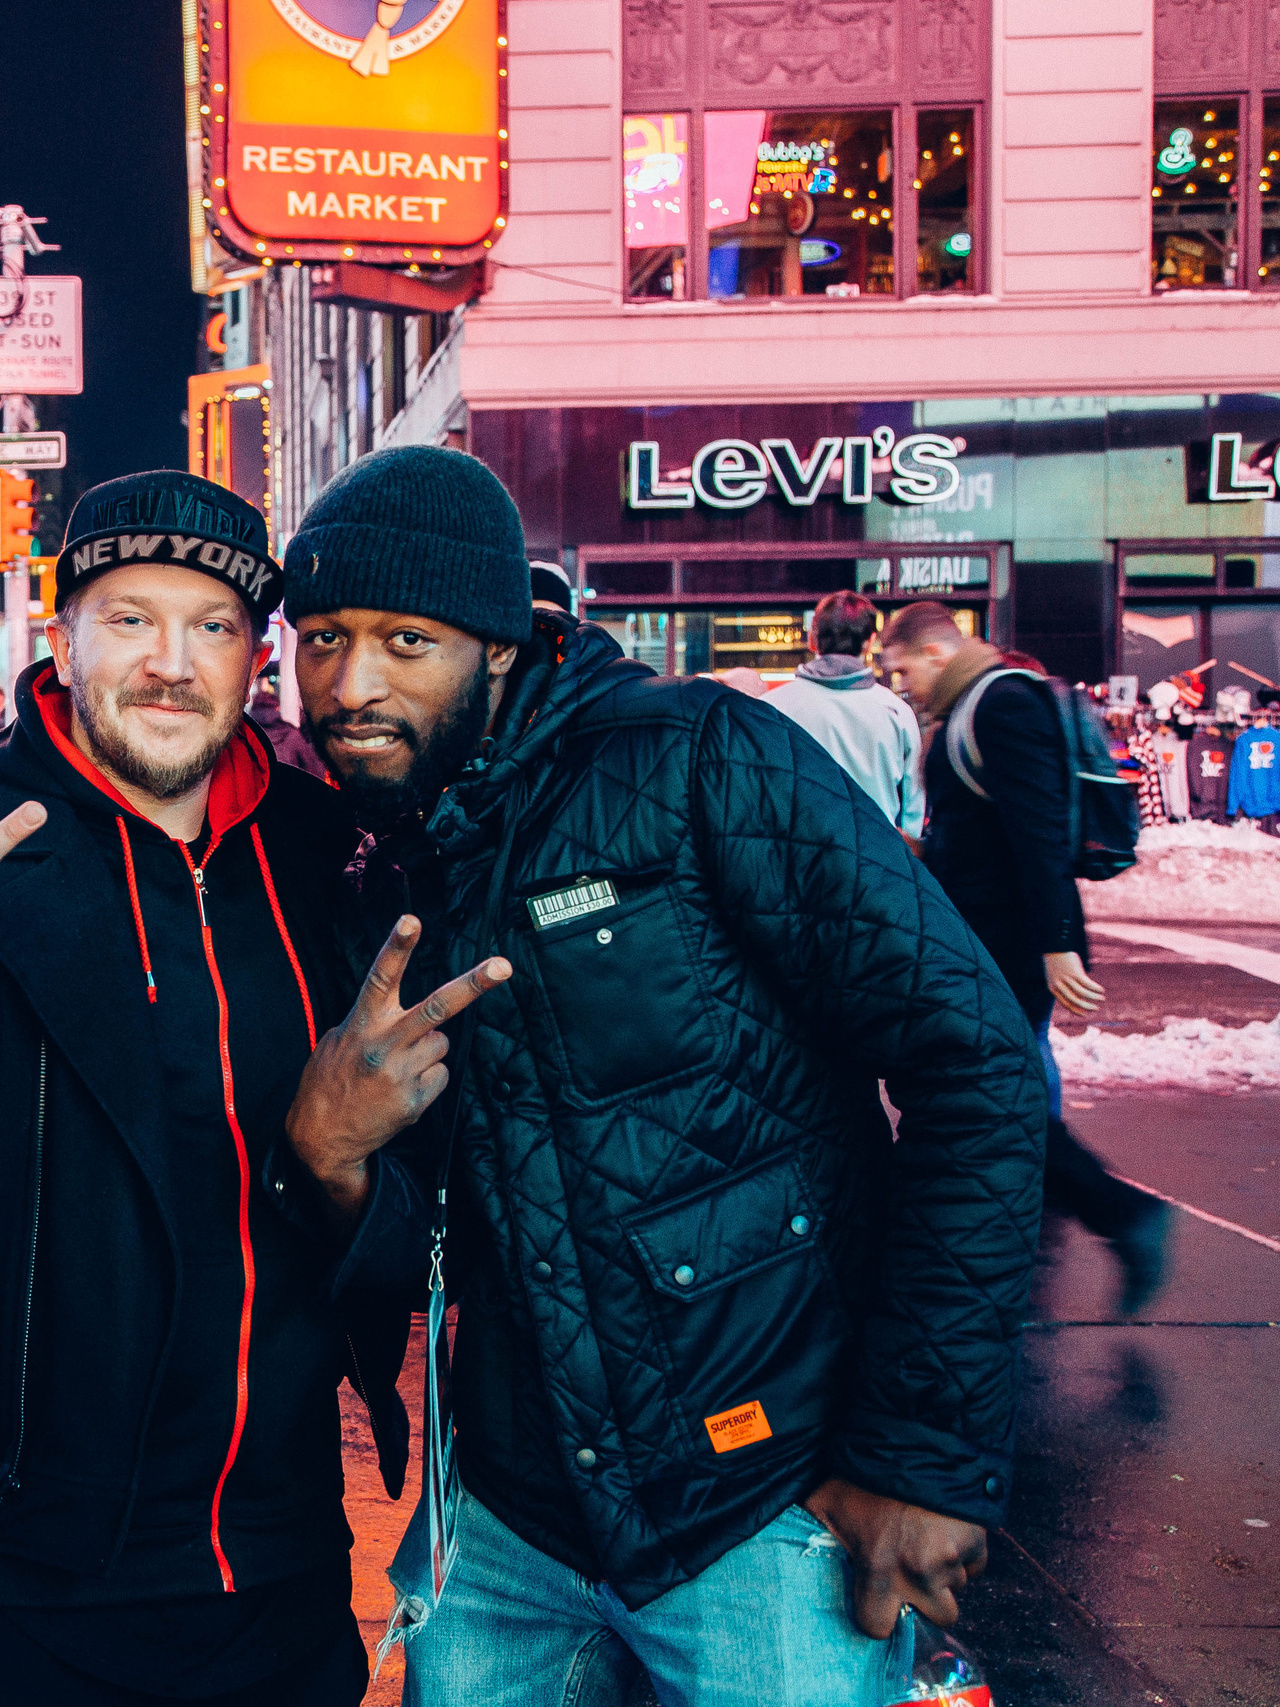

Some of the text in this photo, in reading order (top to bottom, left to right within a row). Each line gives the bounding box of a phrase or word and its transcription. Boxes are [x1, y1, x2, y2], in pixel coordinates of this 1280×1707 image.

[242, 145, 489, 183] RESTAURANT
[757, 141, 825, 161] Bubba's
[286, 190, 448, 224] MARKET
[33, 289, 58, 307] ST
[25, 445, 53, 455] WAY
[1208, 432, 1280, 501] L
[91, 489, 167, 533] NEW
[72, 534, 274, 602] NEW YORK
[541, 897, 613, 924] ADMISSION $30.00
[710, 1409, 758, 1434] SUPERDRY
